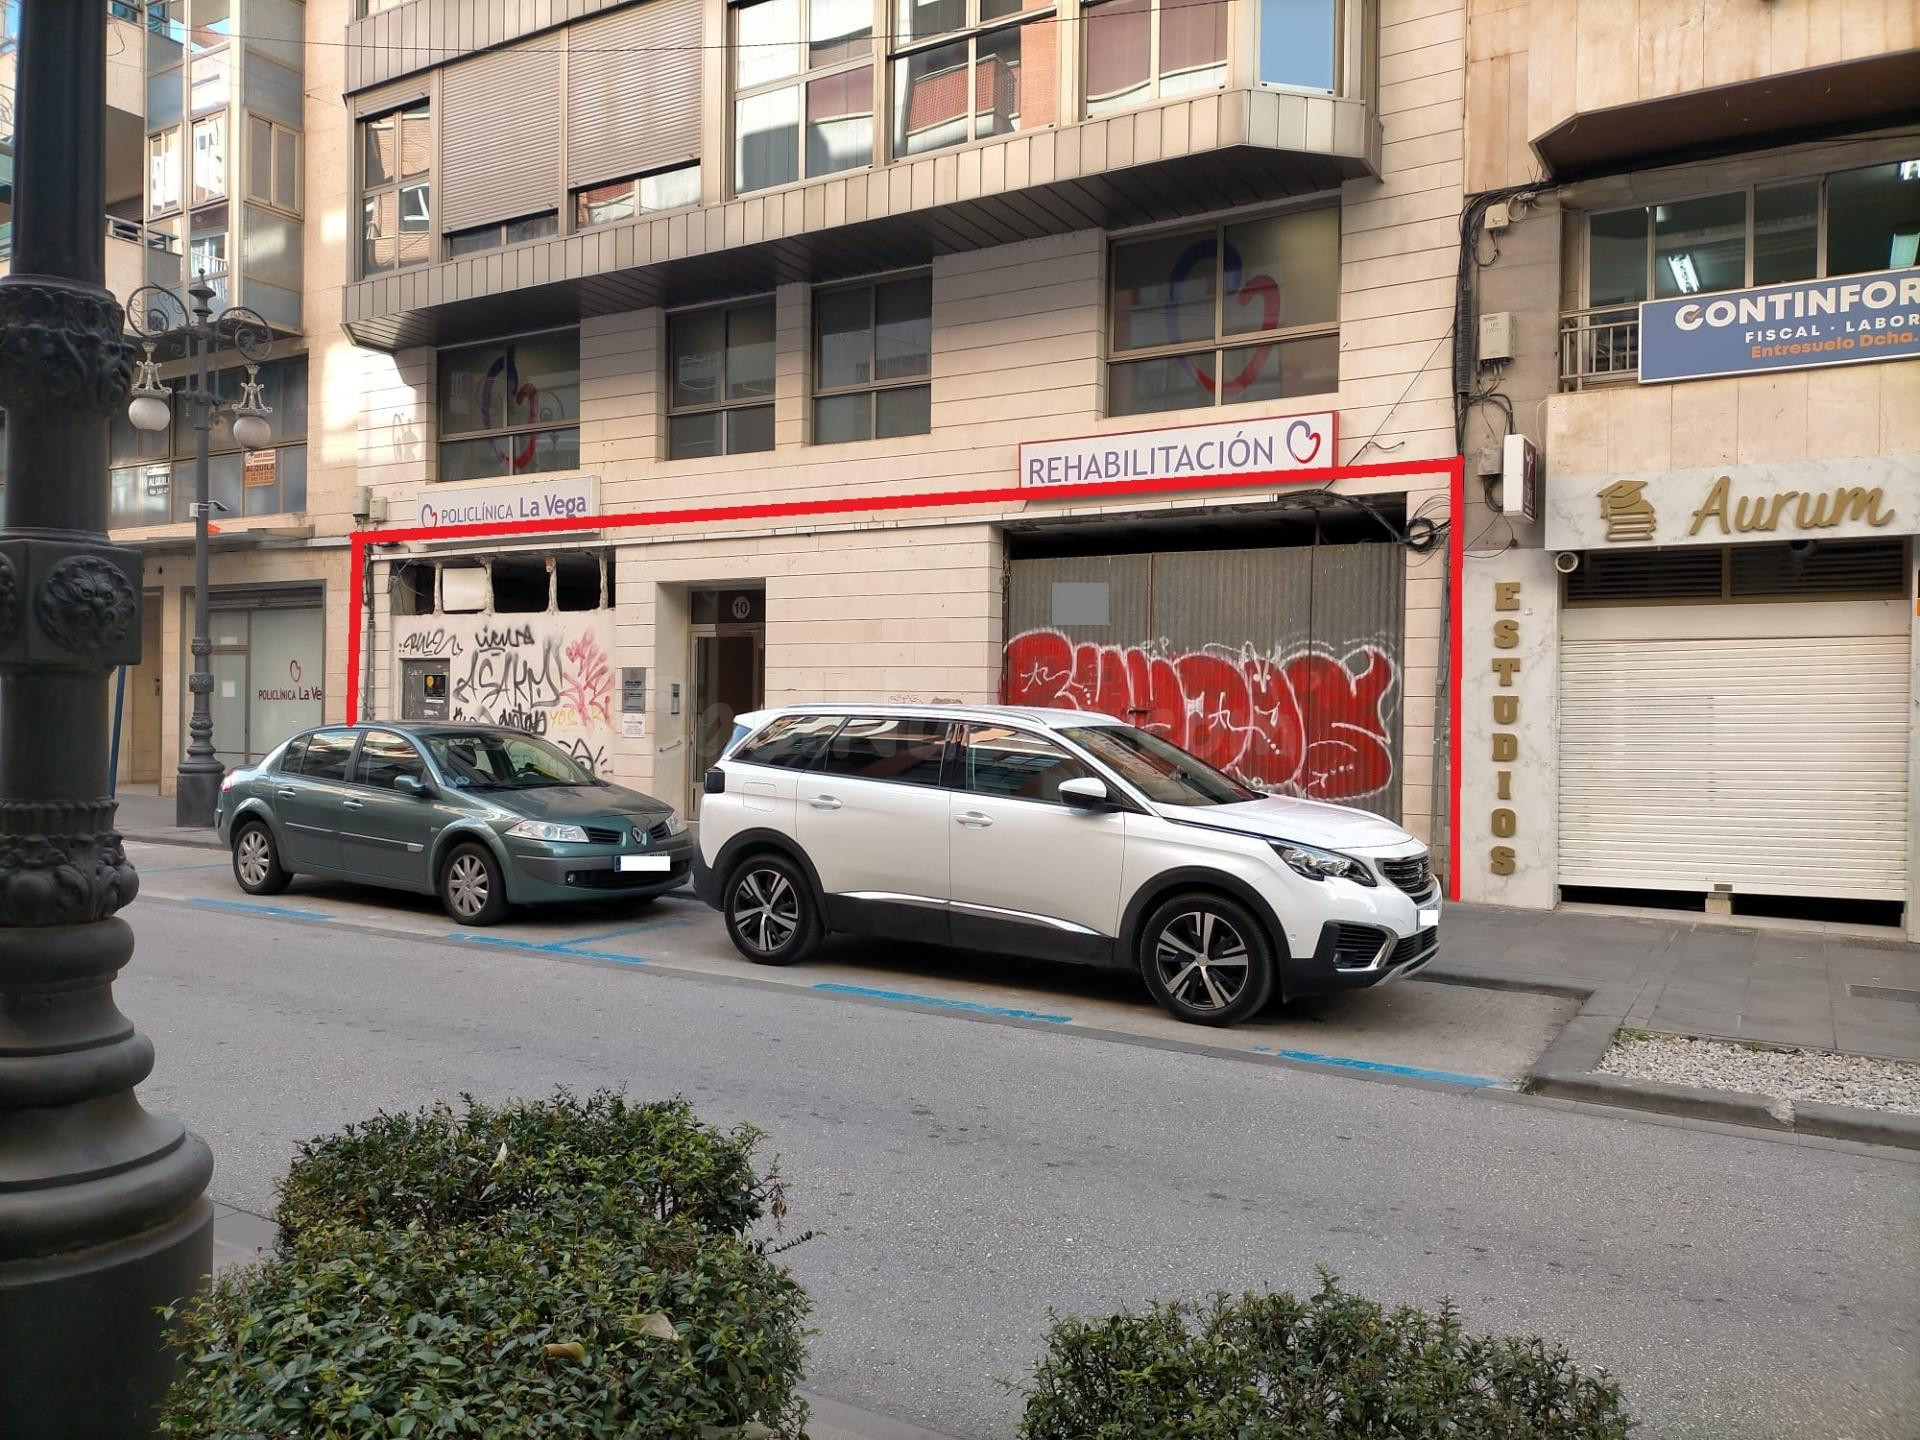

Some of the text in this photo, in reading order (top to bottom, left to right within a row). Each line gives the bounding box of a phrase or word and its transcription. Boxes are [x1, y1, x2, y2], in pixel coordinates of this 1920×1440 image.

[1745, 313, 1920, 343] FISCAL LABOR
[1751, 333, 1855, 359] Entresuelo
[1029, 431, 1273, 484] REHABILITACIÓN
[442, 494, 586, 523] POLICLÍNICA La Vega
[1689, 475, 1895, 535] Aurum
[735, 601, 748, 615] 10
[258, 687, 297, 700] POLICLÍNICA
[299, 686, 309, 700] La
[1490, 582, 1520, 876] ESTUDIOS
